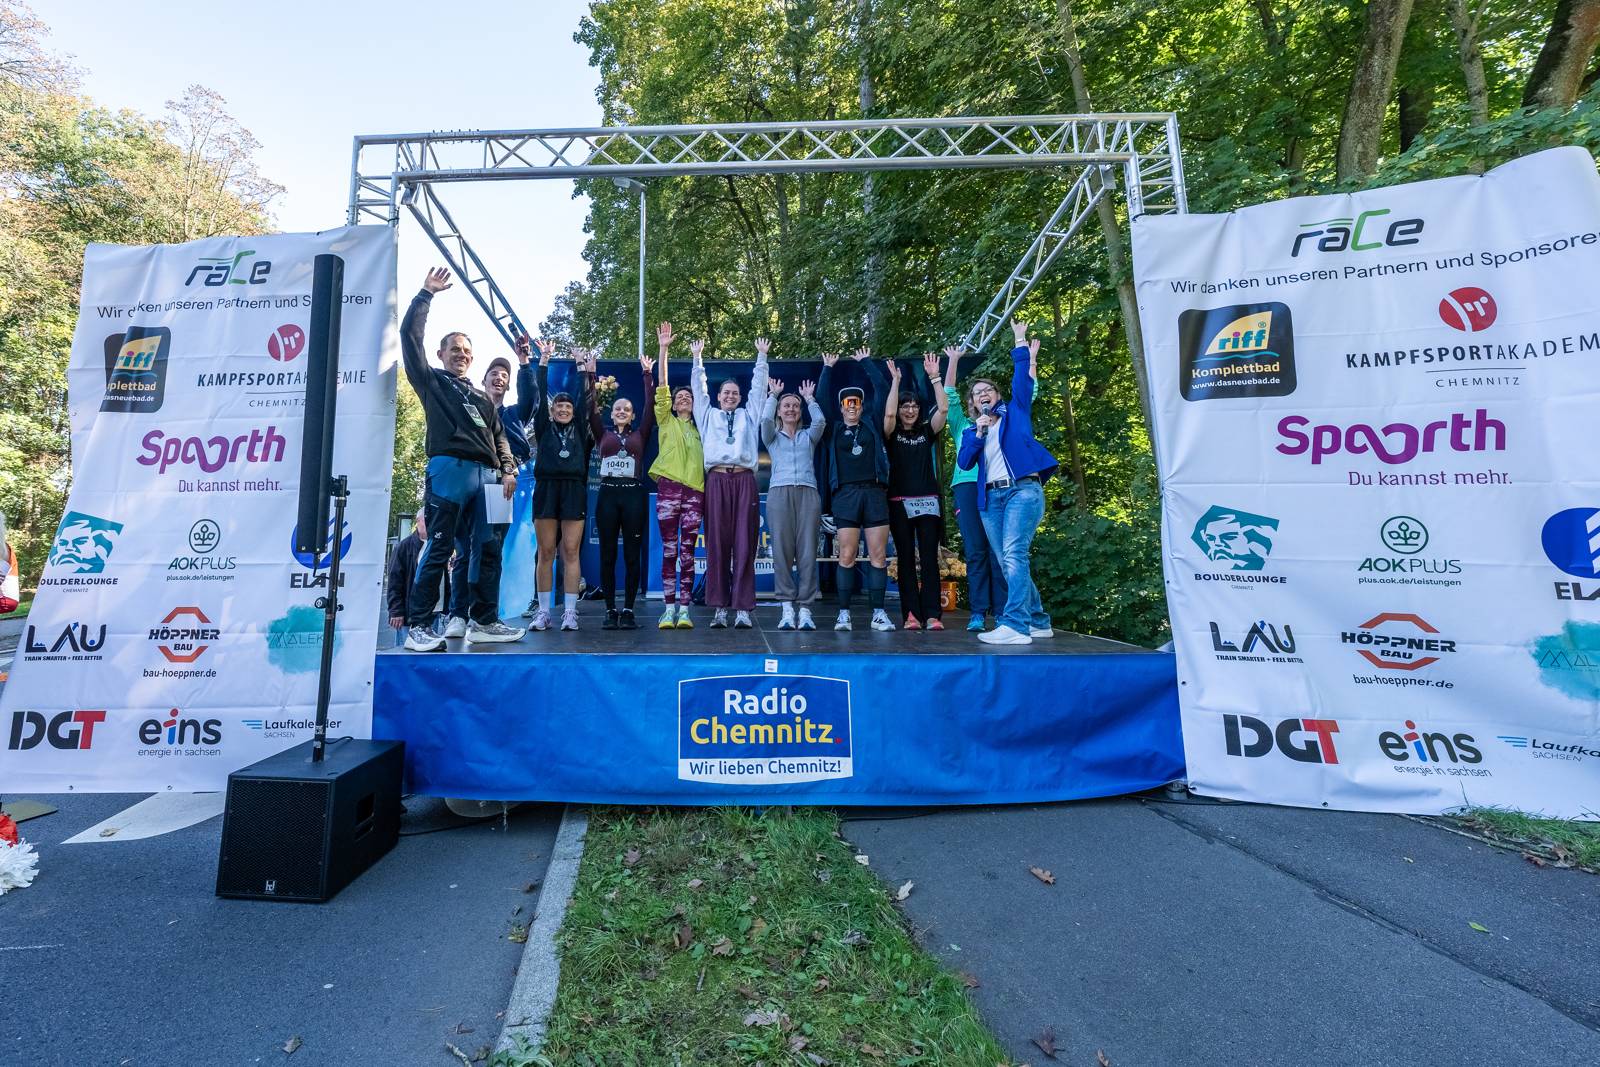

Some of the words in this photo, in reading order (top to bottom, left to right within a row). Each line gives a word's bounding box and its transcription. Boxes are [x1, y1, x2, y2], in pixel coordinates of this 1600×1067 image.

[1170, 281, 1198, 293] Wir
[1200, 278, 1260, 294] danken
[1265, 267, 1339, 287] unseren
[1343, 260, 1429, 280] Partnern
[1435, 252, 1475, 270] und
[97, 306, 123, 319] Wir
[164, 299, 214, 312] unseren
[216, 296, 272, 310] Partnern
[275, 295, 299, 308] und
[1218, 329, 1267, 350] riff
[1191, 361, 1281, 379] Komplettbad
[1191, 376, 1281, 390] www.dasneuebad.de
[1435, 376, 1521, 388] CHEMNITZ
[248, 398, 307, 408] CHEMNITZ
[605, 461, 630, 469] 10401
[178, 479, 194, 493] Du
[197, 478, 241, 492] kannst
[244, 477, 283, 492] mehr.
[1348, 471, 1373, 487] Du
[1378, 469, 1447, 486] kannst
[1454, 469, 1513, 486] mehr.
[40, 578, 119, 587] OULDERLOUNGE
[1194, 573, 1288, 584] BOULDERLOUNGE
[1358, 576, 1462, 587] plus.aok.de/leistungen
[25, 622, 107, 653] LAU
[148, 626, 221, 641] HÖPPNER
[173, 643, 193, 651] BAU
[1341, 631, 1457, 652] HÖPPNER
[1380, 649, 1414, 660] BAU
[143, 668, 217, 680] bau-hoeppner.de
[1352, 673, 1455, 690] bau-hoeppner.de
[723, 687, 808, 715] Radio
[8, 710, 108, 750] DGT
[138, 708, 223, 746] eins
[264, 718, 342, 730] Laufkaleder
[263, 731, 296, 739] SACHSEN
[1222, 713, 1341, 765] DGT
[1378, 719, 1484, 765] eins
[138, 747, 172, 758] energie
[174, 747, 183, 757] in
[184, 746, 222, 757] sachsen
[1532, 751, 1583, 763] SACHSEN
[690, 761, 715, 775] Wir
[718, 760, 764, 775] lieben
[767, 759, 842, 774] Chemnitz!
[1393, 764, 1432, 777] energie
[1434, 765, 1446, 776] in
[1448, 766, 1493, 778] sachsen
